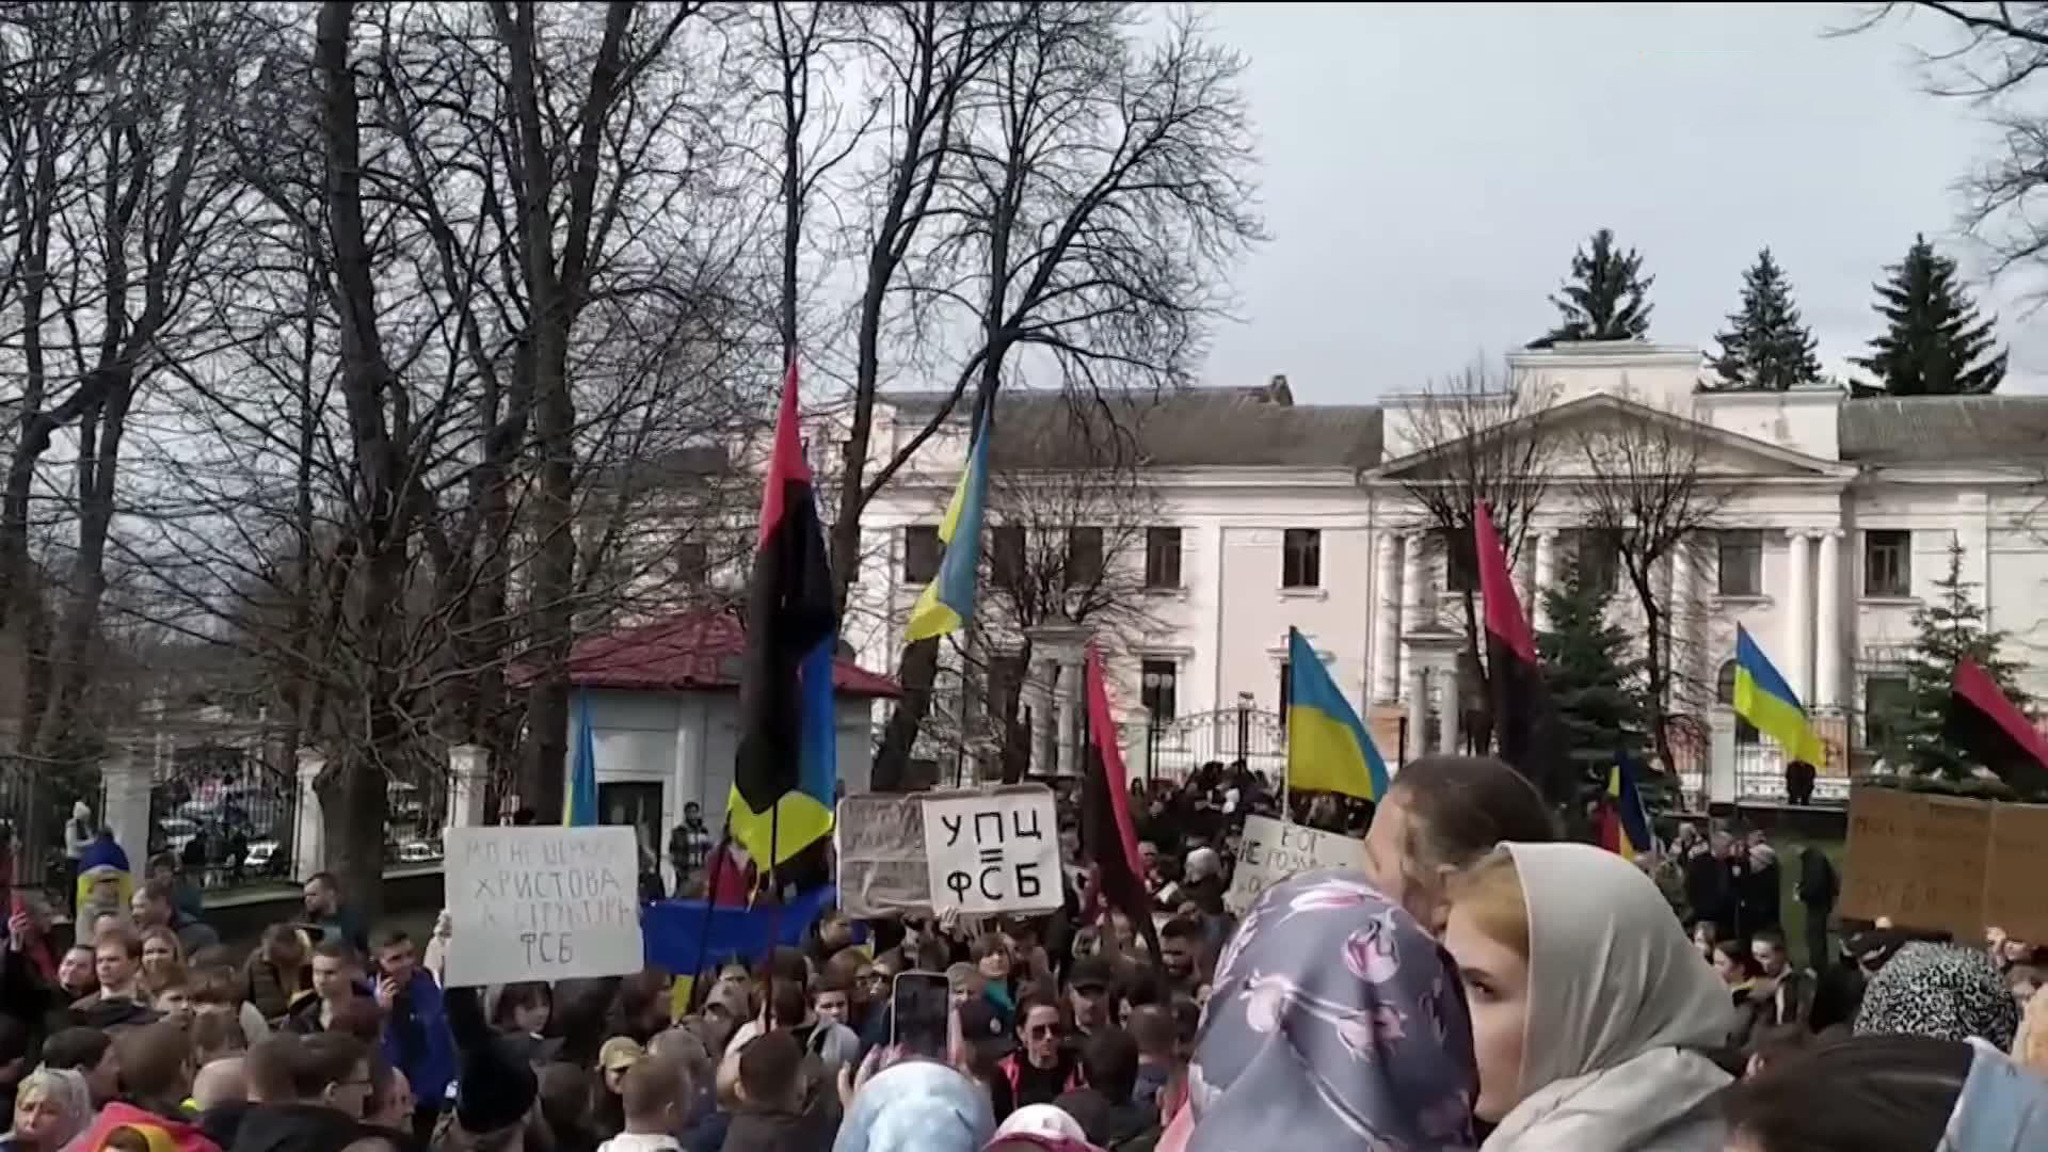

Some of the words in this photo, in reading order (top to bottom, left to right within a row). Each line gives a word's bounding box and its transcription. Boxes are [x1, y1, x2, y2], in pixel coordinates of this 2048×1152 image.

[941, 807, 1041, 847] УПЦ
[475, 866, 621, 899] ХРИСТОВА
[947, 862, 1041, 904] ФСБ
